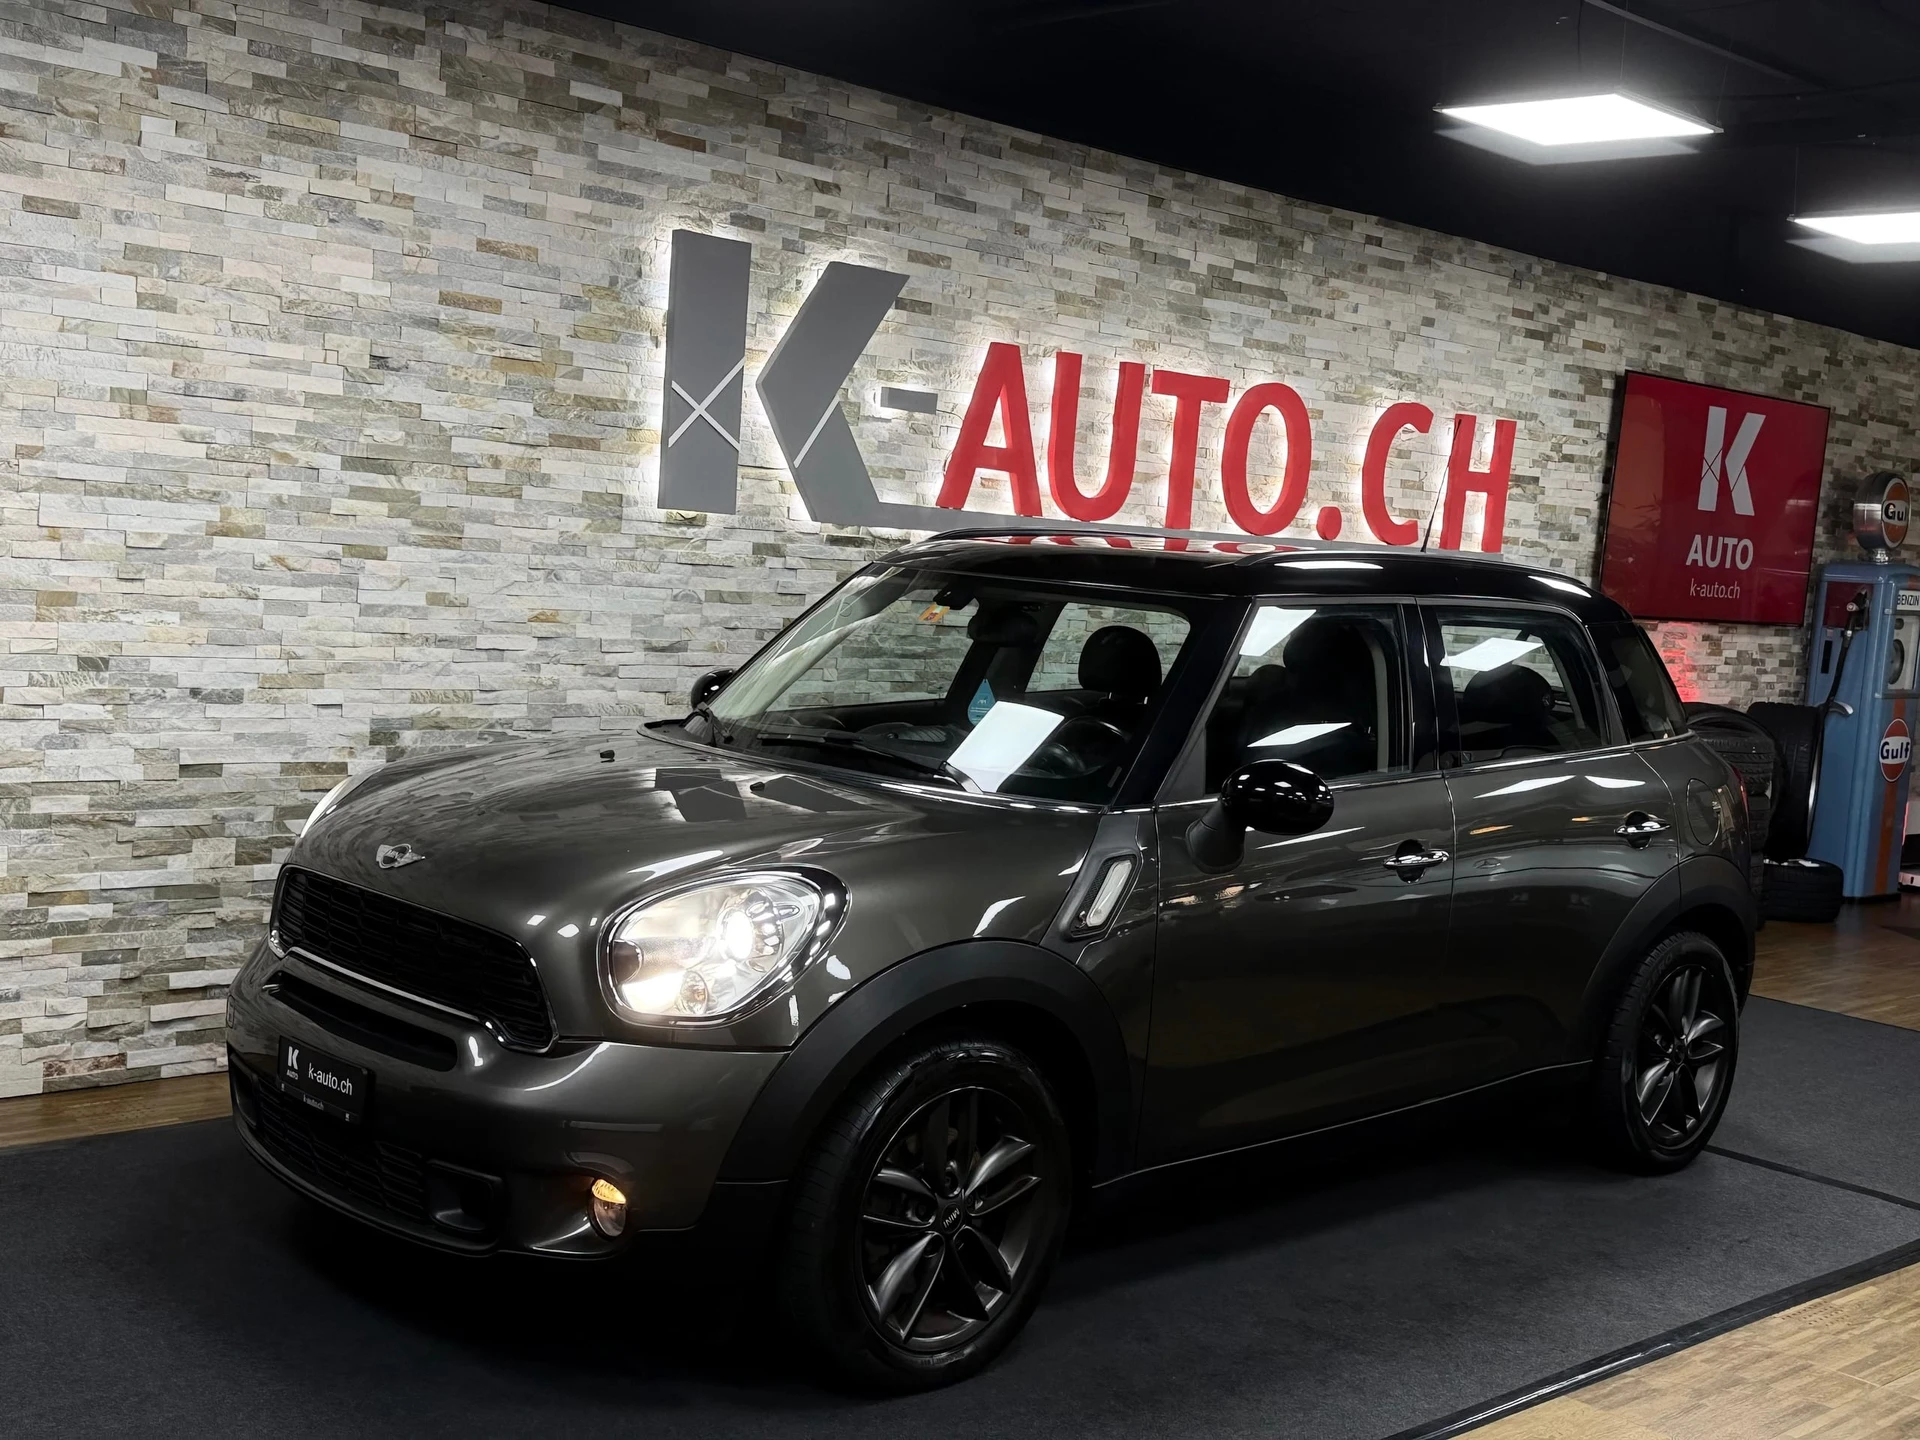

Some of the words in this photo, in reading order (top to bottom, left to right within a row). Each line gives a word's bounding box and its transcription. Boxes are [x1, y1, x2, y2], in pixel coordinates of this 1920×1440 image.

[658, 229, 1516, 553] K-AUTO.CH
[1698, 405, 1766, 516] K
[1884, 502, 1908, 521] Gul
[1686, 534, 1754, 570] AUTO
[1689, 577, 1741, 599] k-auto.ch
[1880, 741, 1910, 760] Gulf
[287, 1046, 300, 1070] K
[308, 1062, 353, 1096] k-auto.ch
[943, 1207, 960, 1228] MINI
